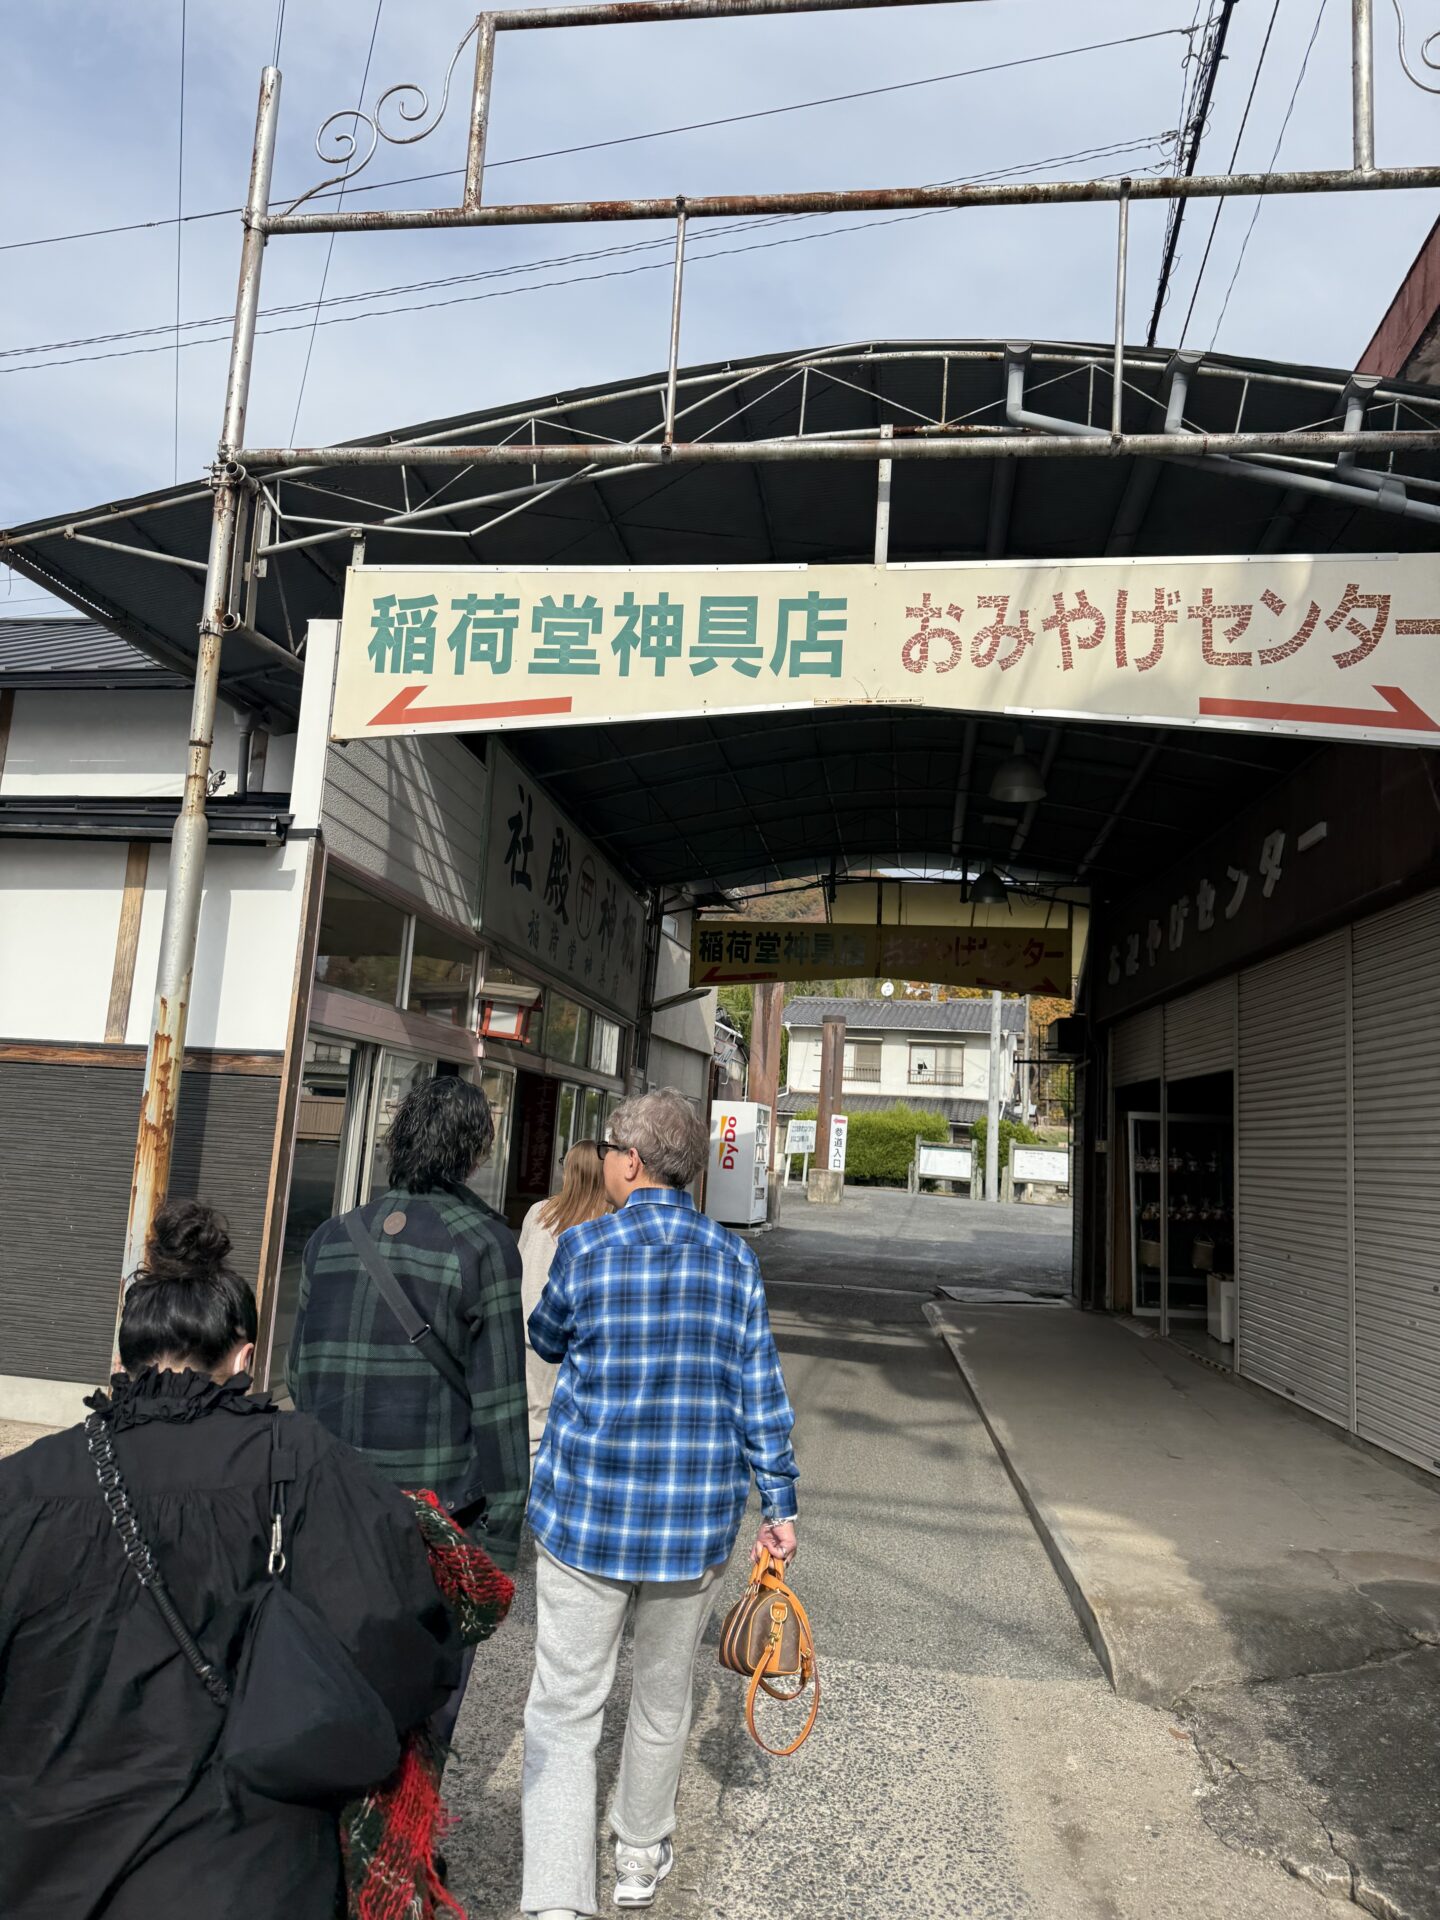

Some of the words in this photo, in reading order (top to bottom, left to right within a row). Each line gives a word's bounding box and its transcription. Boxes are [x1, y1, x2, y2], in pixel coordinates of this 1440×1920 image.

[367, 590, 849, 679] 稲荷堂神具店
[901, 583, 1440, 673] おみやげセンター
[722, 1116, 739, 1170] DyDo
[833, 1127, 843, 1168] 参道入口
